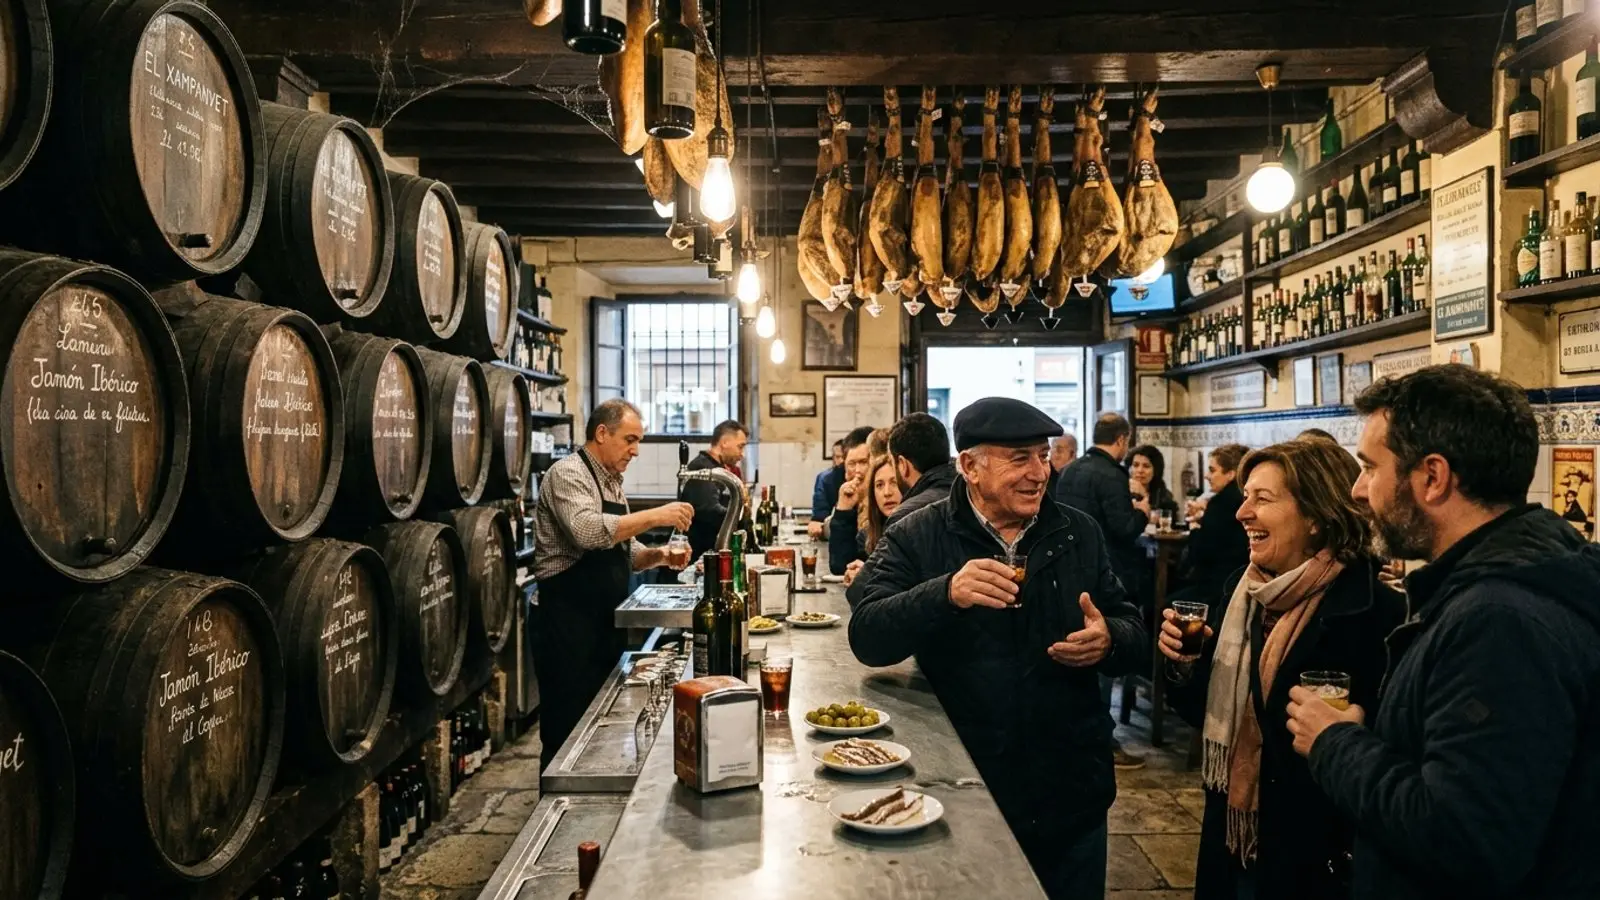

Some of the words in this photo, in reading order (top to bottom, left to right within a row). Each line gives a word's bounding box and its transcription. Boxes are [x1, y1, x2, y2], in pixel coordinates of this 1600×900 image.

[145, 50, 161, 78] EL
[31, 357, 85, 390] Jamón
[160, 665, 200, 708] Jamón
